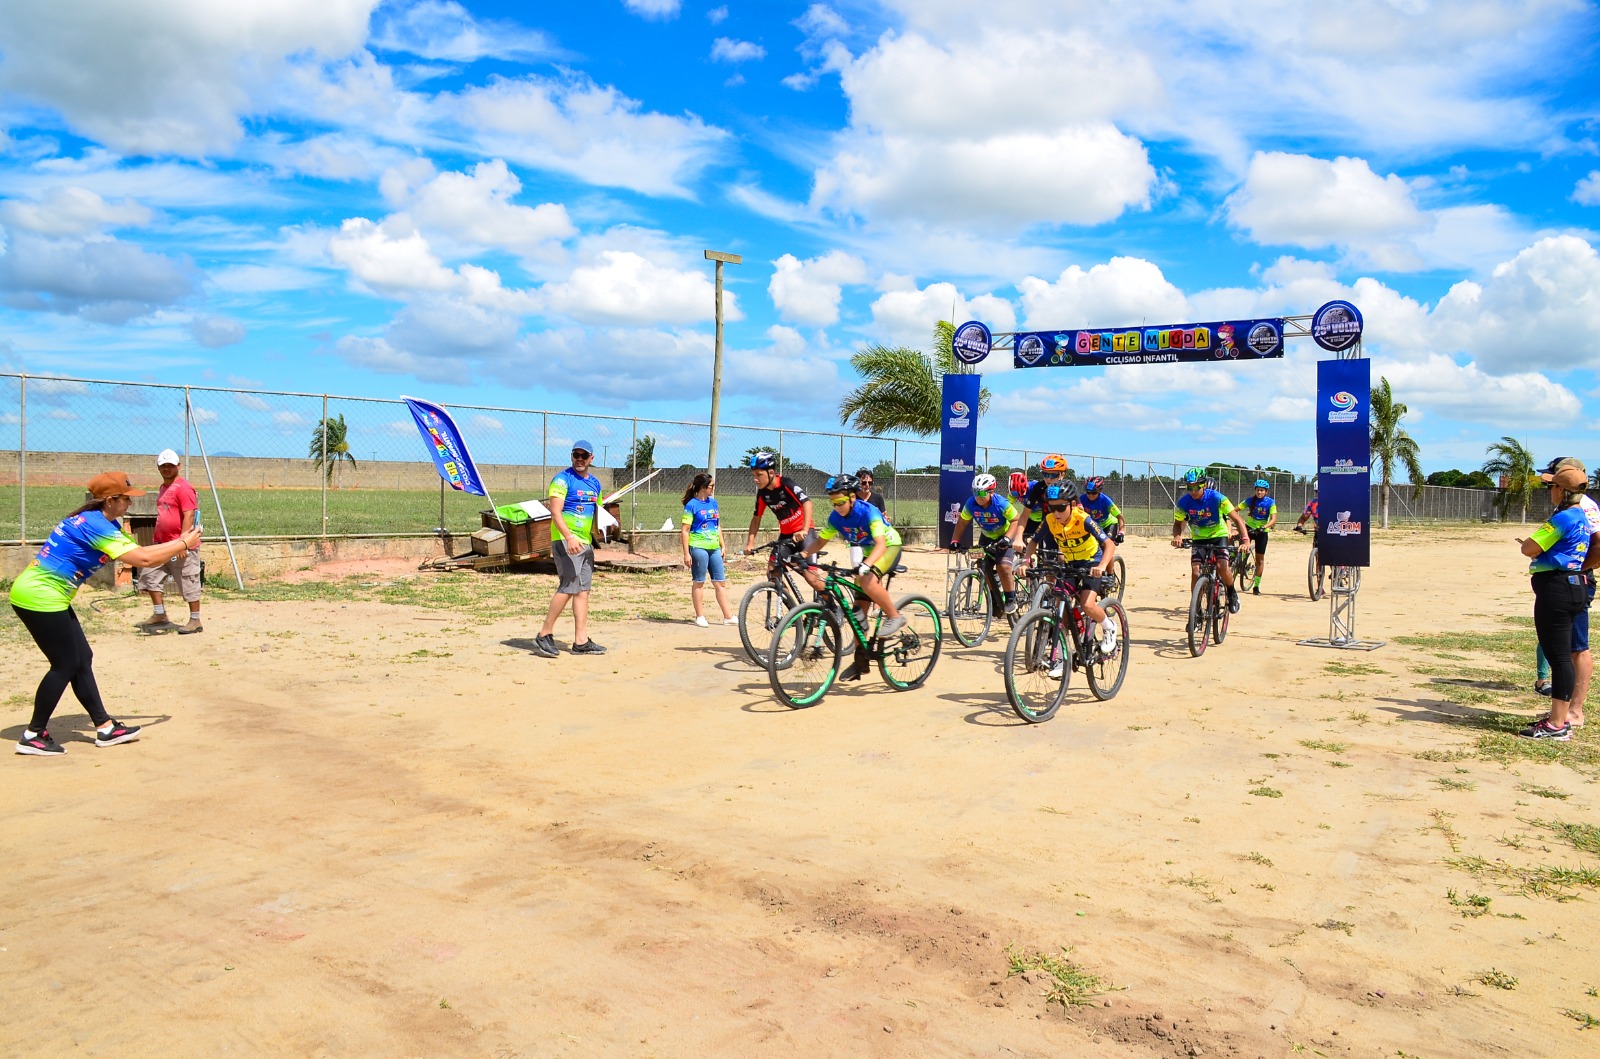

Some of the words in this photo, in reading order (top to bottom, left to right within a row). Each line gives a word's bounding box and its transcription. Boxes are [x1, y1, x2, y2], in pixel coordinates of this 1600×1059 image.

[1331, 321, 1361, 334] VOLTA
[1078, 334, 1137, 350] GENTE
[1145, 330, 1207, 346] MIÚDA
[1105, 355, 1142, 364] CICLISMO
[1143, 353, 1179, 363] INFANTIL
[1327, 521, 1361, 532] ASCOM
